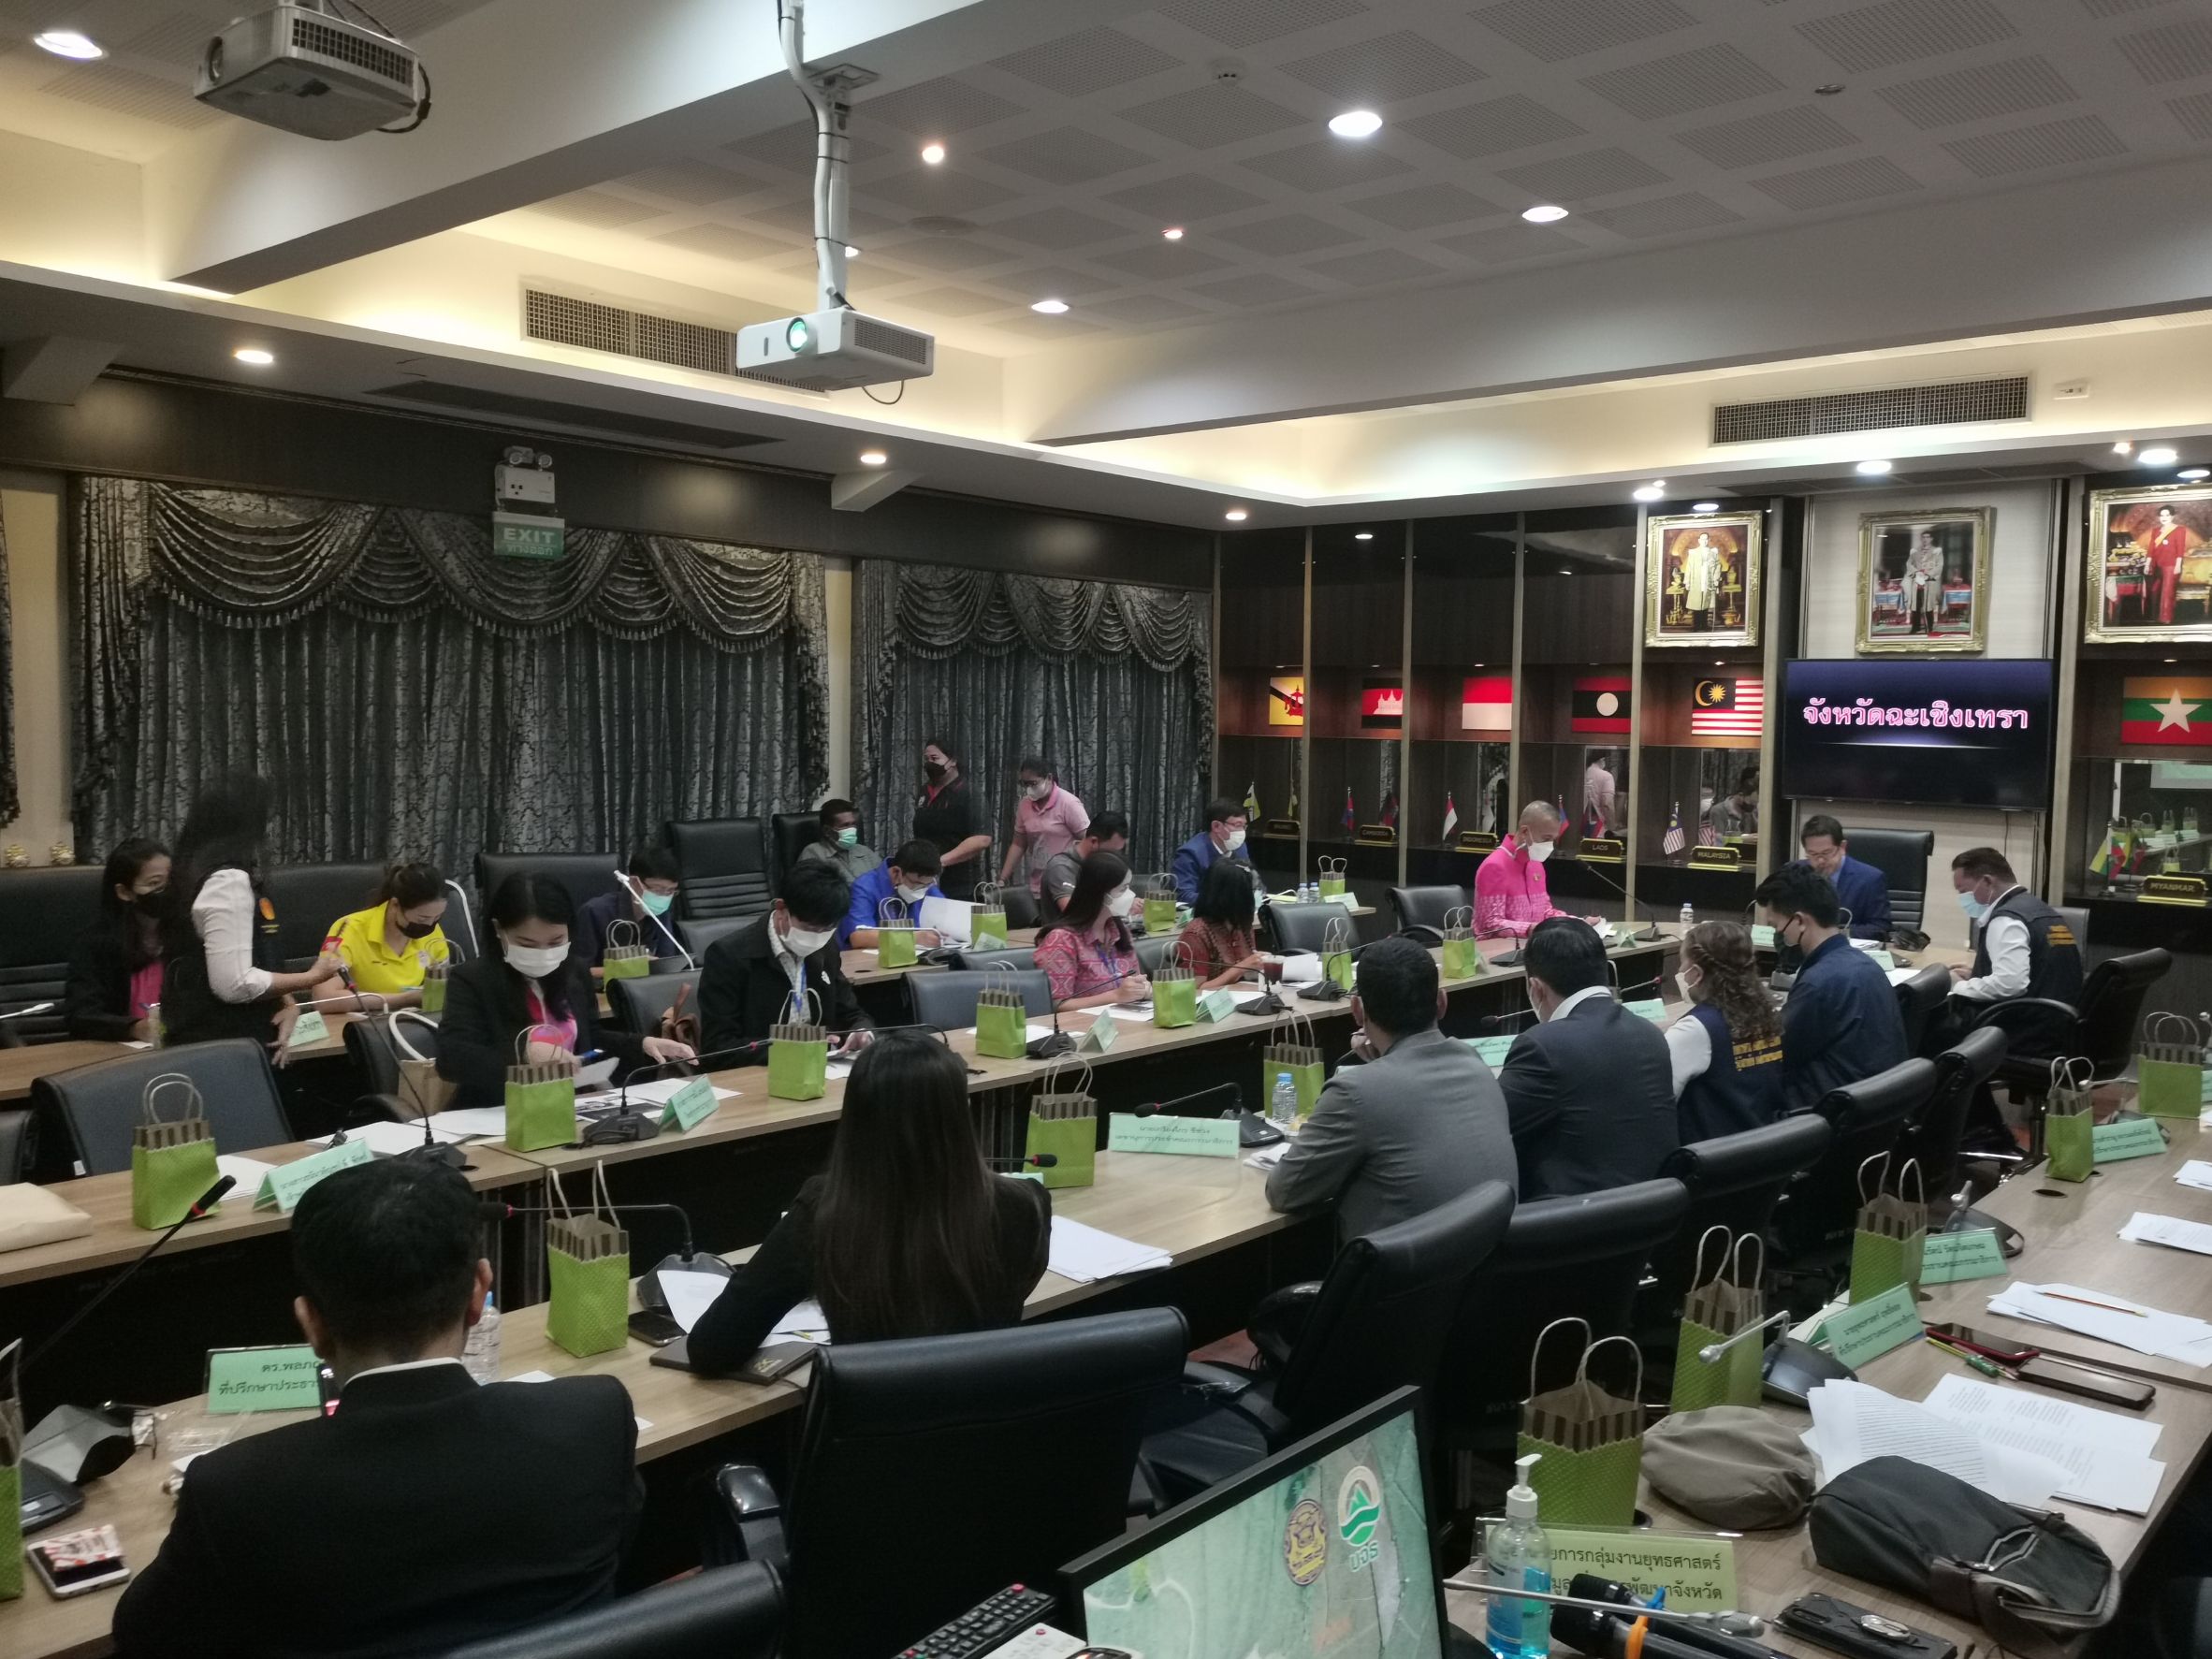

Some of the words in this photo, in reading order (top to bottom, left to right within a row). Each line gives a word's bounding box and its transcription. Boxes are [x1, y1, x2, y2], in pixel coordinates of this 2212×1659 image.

[504, 528, 554, 544] EXIT
[505, 544, 554, 557] ทางออก
[1802, 696, 2030, 729] จังหวัดฉะเชิงเทรา
[1697, 851, 1731, 860] MALAYSIA
[2148, 882, 2195, 893] MYANMAR
[218, 1379, 319, 1395] ที่ปรึกษาประธา
